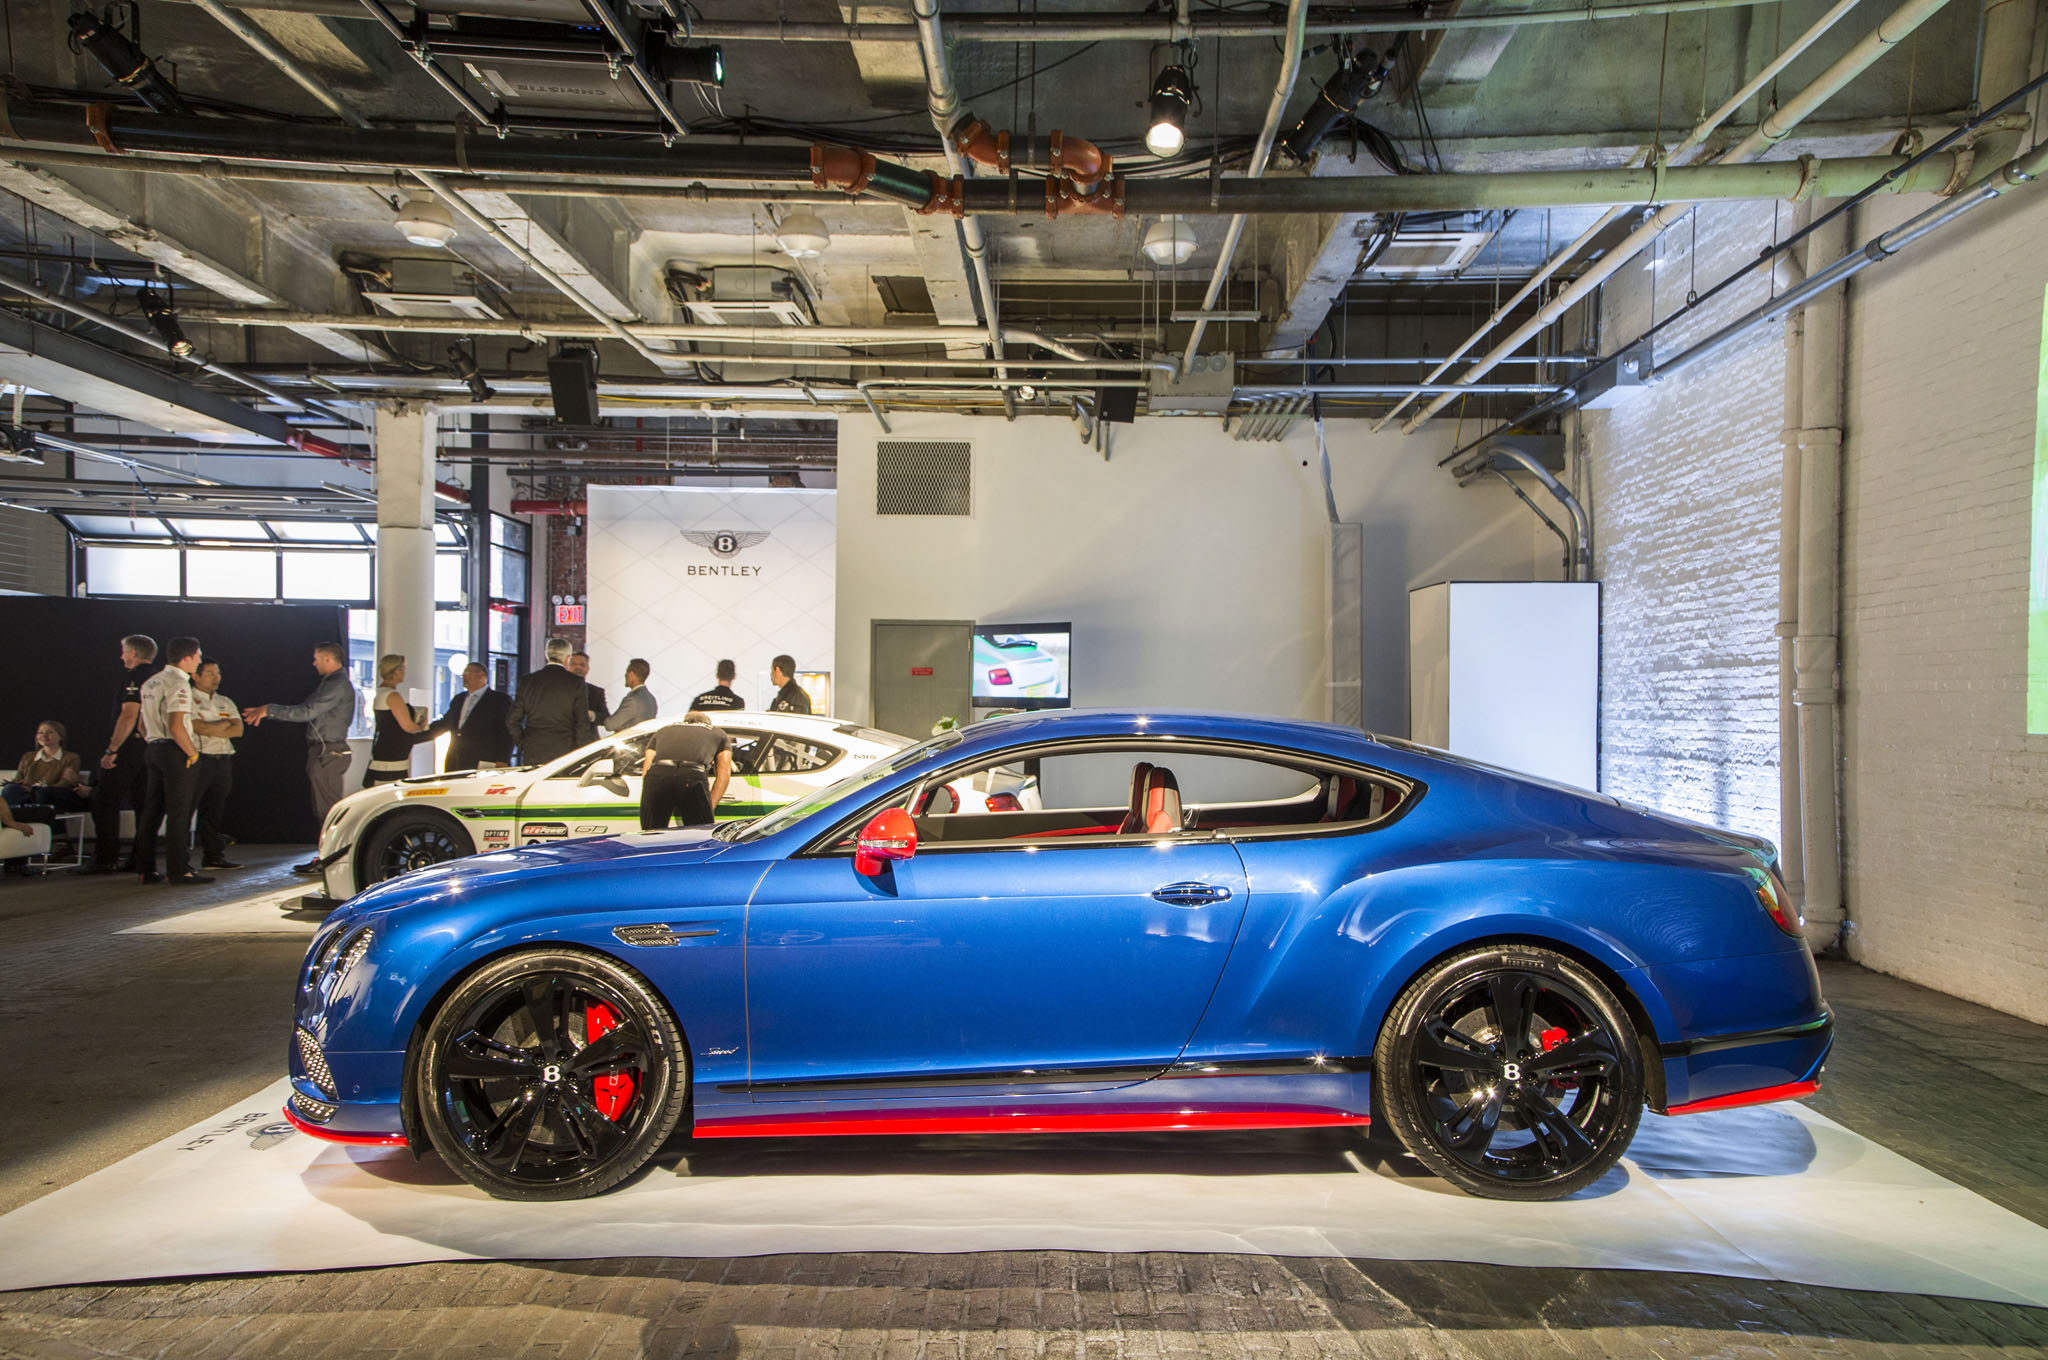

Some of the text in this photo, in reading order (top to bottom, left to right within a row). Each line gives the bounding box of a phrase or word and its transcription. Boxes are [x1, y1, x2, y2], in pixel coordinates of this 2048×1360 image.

[517, 84, 606, 95] CHRISTIE
[687, 565, 762, 576] BENTLEY
[559, 606, 582, 624] EXIT
[543, 1065, 561, 1083] B
[1503, 1063, 1521, 1081] B
[176, 1113, 268, 1151] BENTLEY
